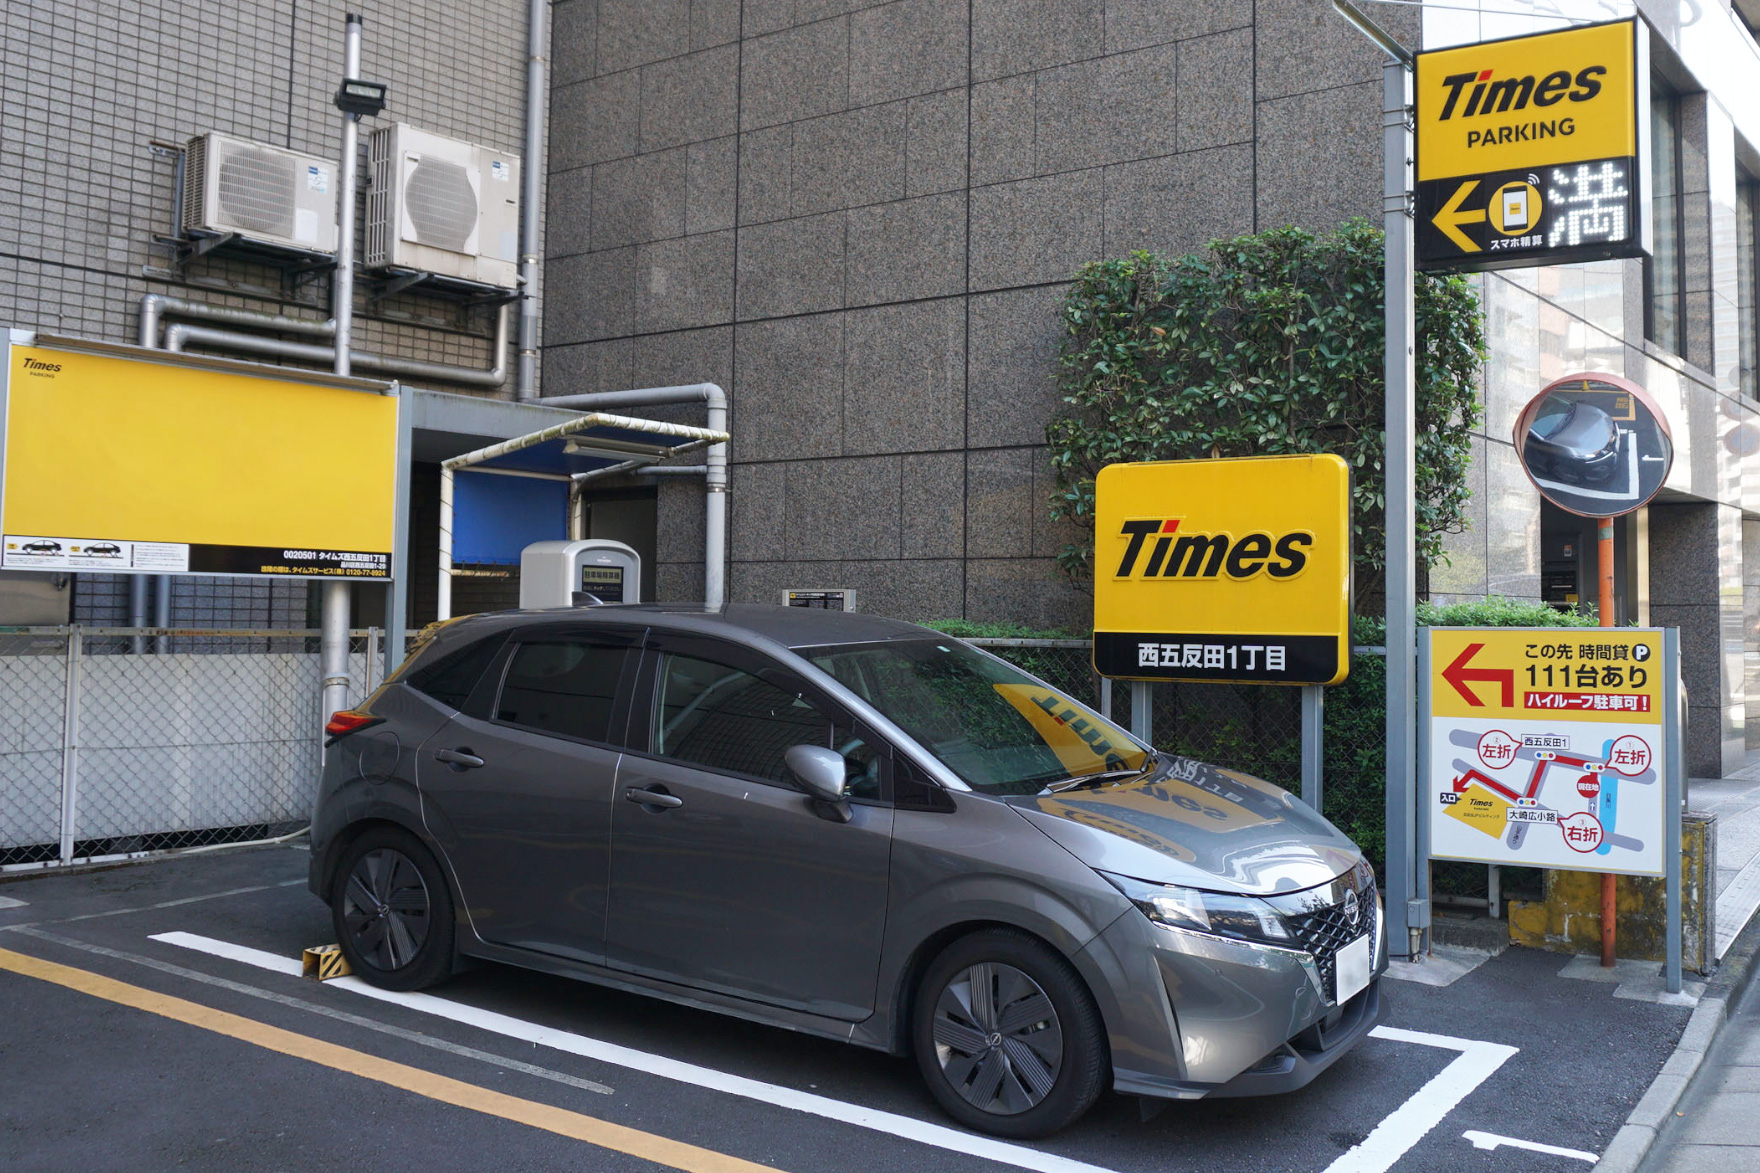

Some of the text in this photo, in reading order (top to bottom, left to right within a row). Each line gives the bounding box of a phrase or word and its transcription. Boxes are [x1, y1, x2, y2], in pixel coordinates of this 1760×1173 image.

[1439, 65, 1607, 121] Times
[1467, 117, 1576, 148] PARKING
[1549, 163, 1628, 247] 満
[1490, 234, 1543, 250] スマホ精算
[23, 357, 62, 372] Times
[283, 550, 386, 563] 0020501 タイムズ西五反田1丁目
[1116, 519, 1313, 578] Times
[1138, 643, 1286, 671] 西五反田1丁目
[1525, 643, 1573, 660] この先
[1579, 644, 1629, 661] 時間貸
[1525, 664, 1648, 689] 111台あり
[1527, 693, 1648, 711] ハイルーフ駐車可！
[1524, 737, 1567, 747] 西五反田1
[1482, 743, 1512, 759] 左折
[1614, 749, 1646, 765] 左折
[1440, 794, 1456, 803] 入口
[1469, 798, 1494, 807] Times
[1509, 810, 1556, 822] 大崎広小路
[1567, 826, 1598, 842] 右折
